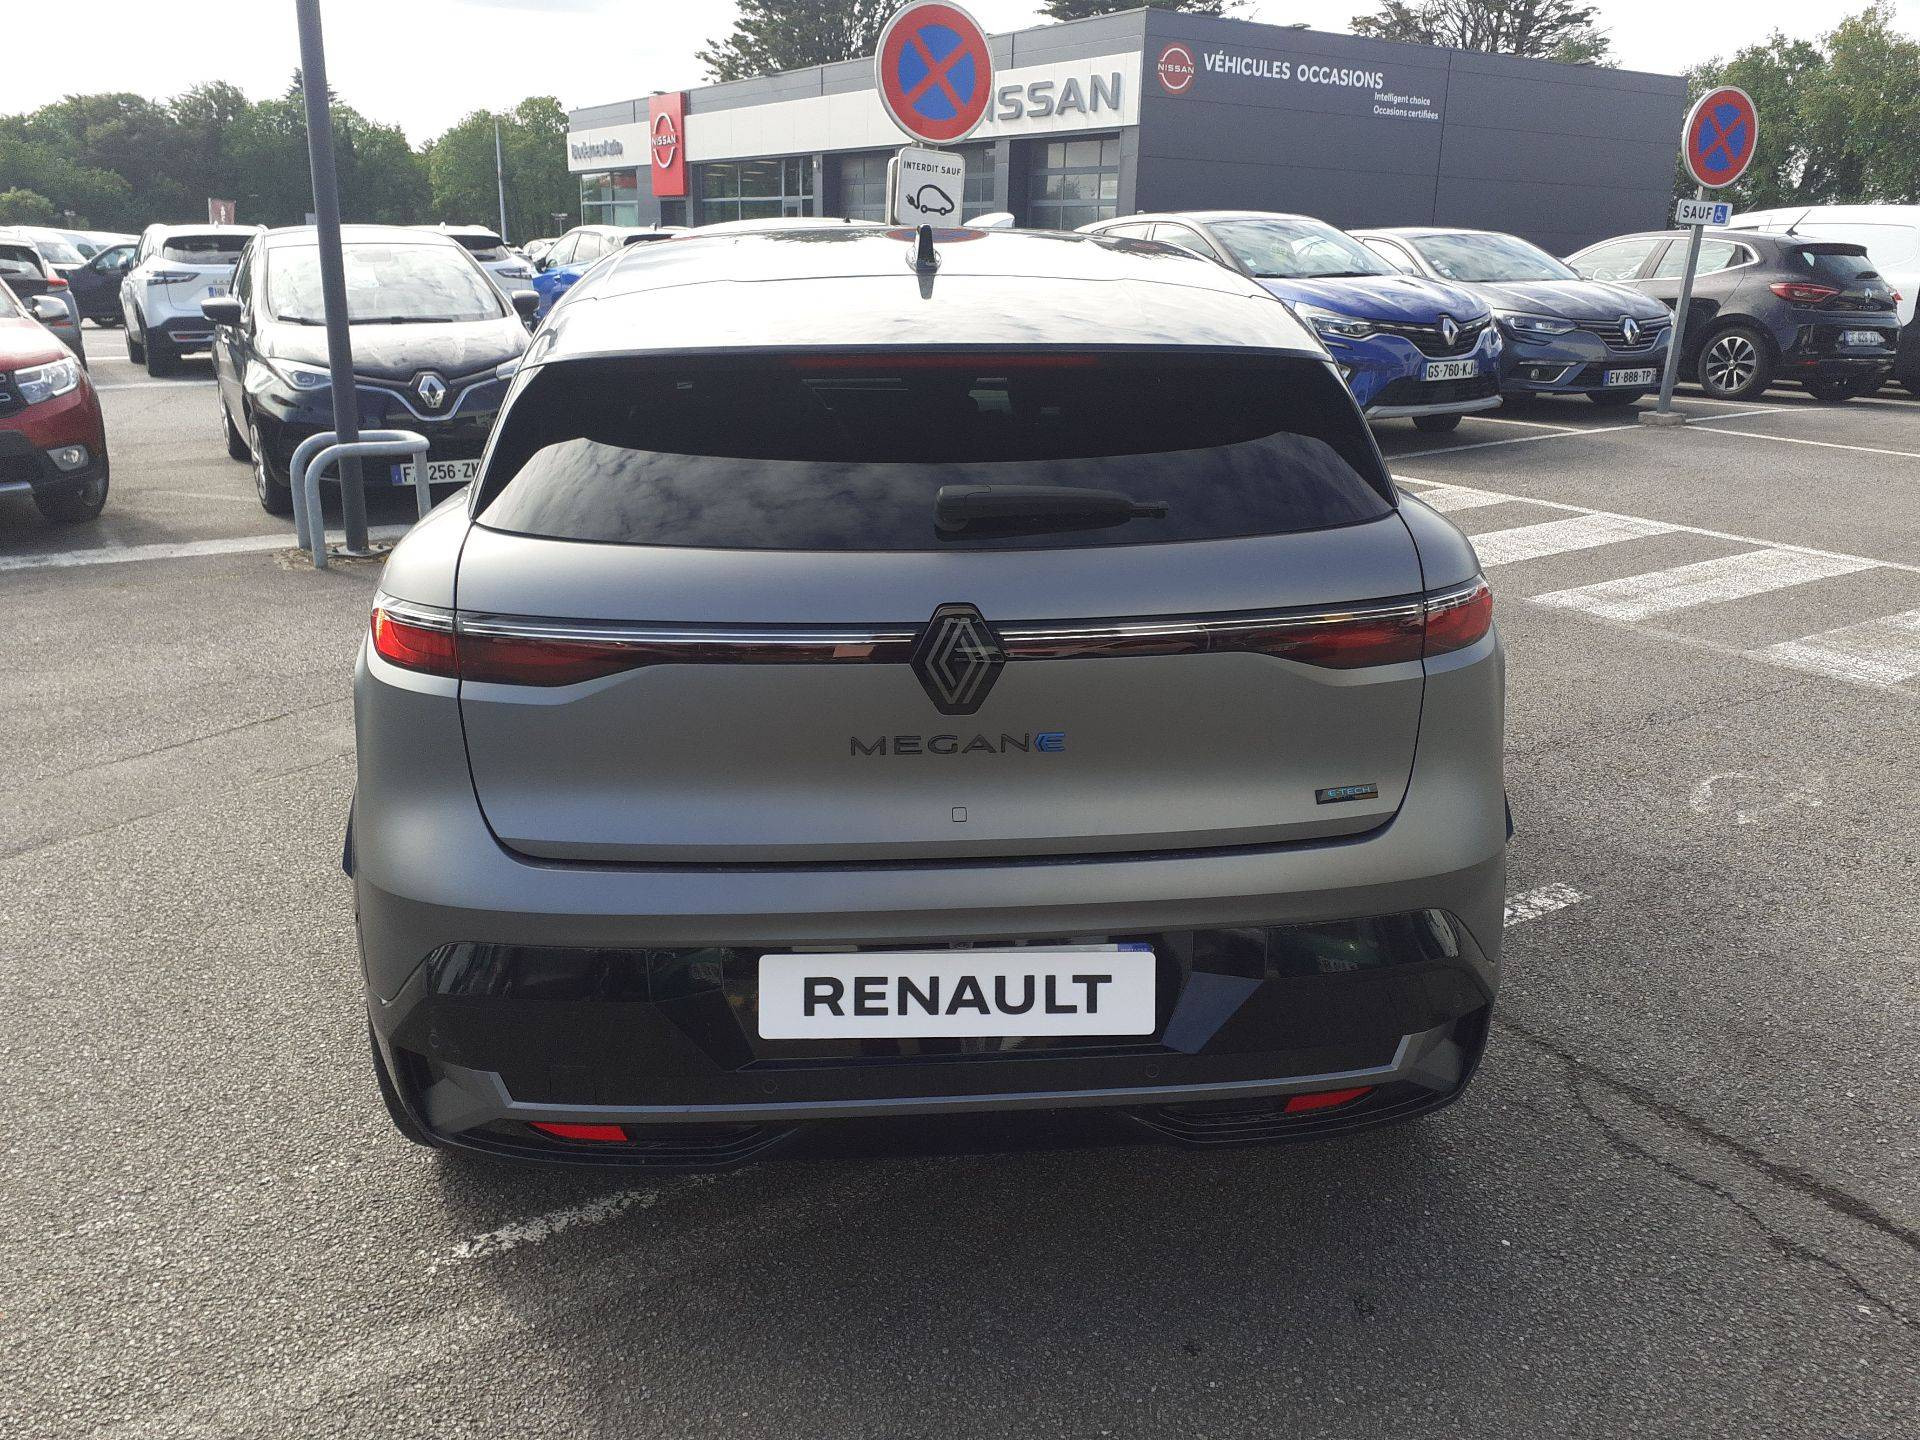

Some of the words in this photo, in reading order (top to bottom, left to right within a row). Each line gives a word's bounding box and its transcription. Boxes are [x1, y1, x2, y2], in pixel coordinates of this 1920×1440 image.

[1157, 63, 1194, 74] NISSAN
[1203, 50, 1291, 80] VÉHICULES
[1297, 64, 1384, 89] OCCASIONS
[1374, 92, 1409, 104] Intelligent
[1409, 96, 1431, 106] choice
[1373, 105, 1408, 117] Occasions
[1408, 109, 1439, 120] certifiées
[652, 135, 677, 146] NISSAN
[903, 160, 939, 173] INTERDIT
[941, 166, 962, 176] SAUF
[1682, 205, 1714, 220] SAUF
[850, 731, 1065, 756] MEGANE
[1327, 786, 1371, 798] E-TECH
[803, 973, 1113, 1017] RENAULT
